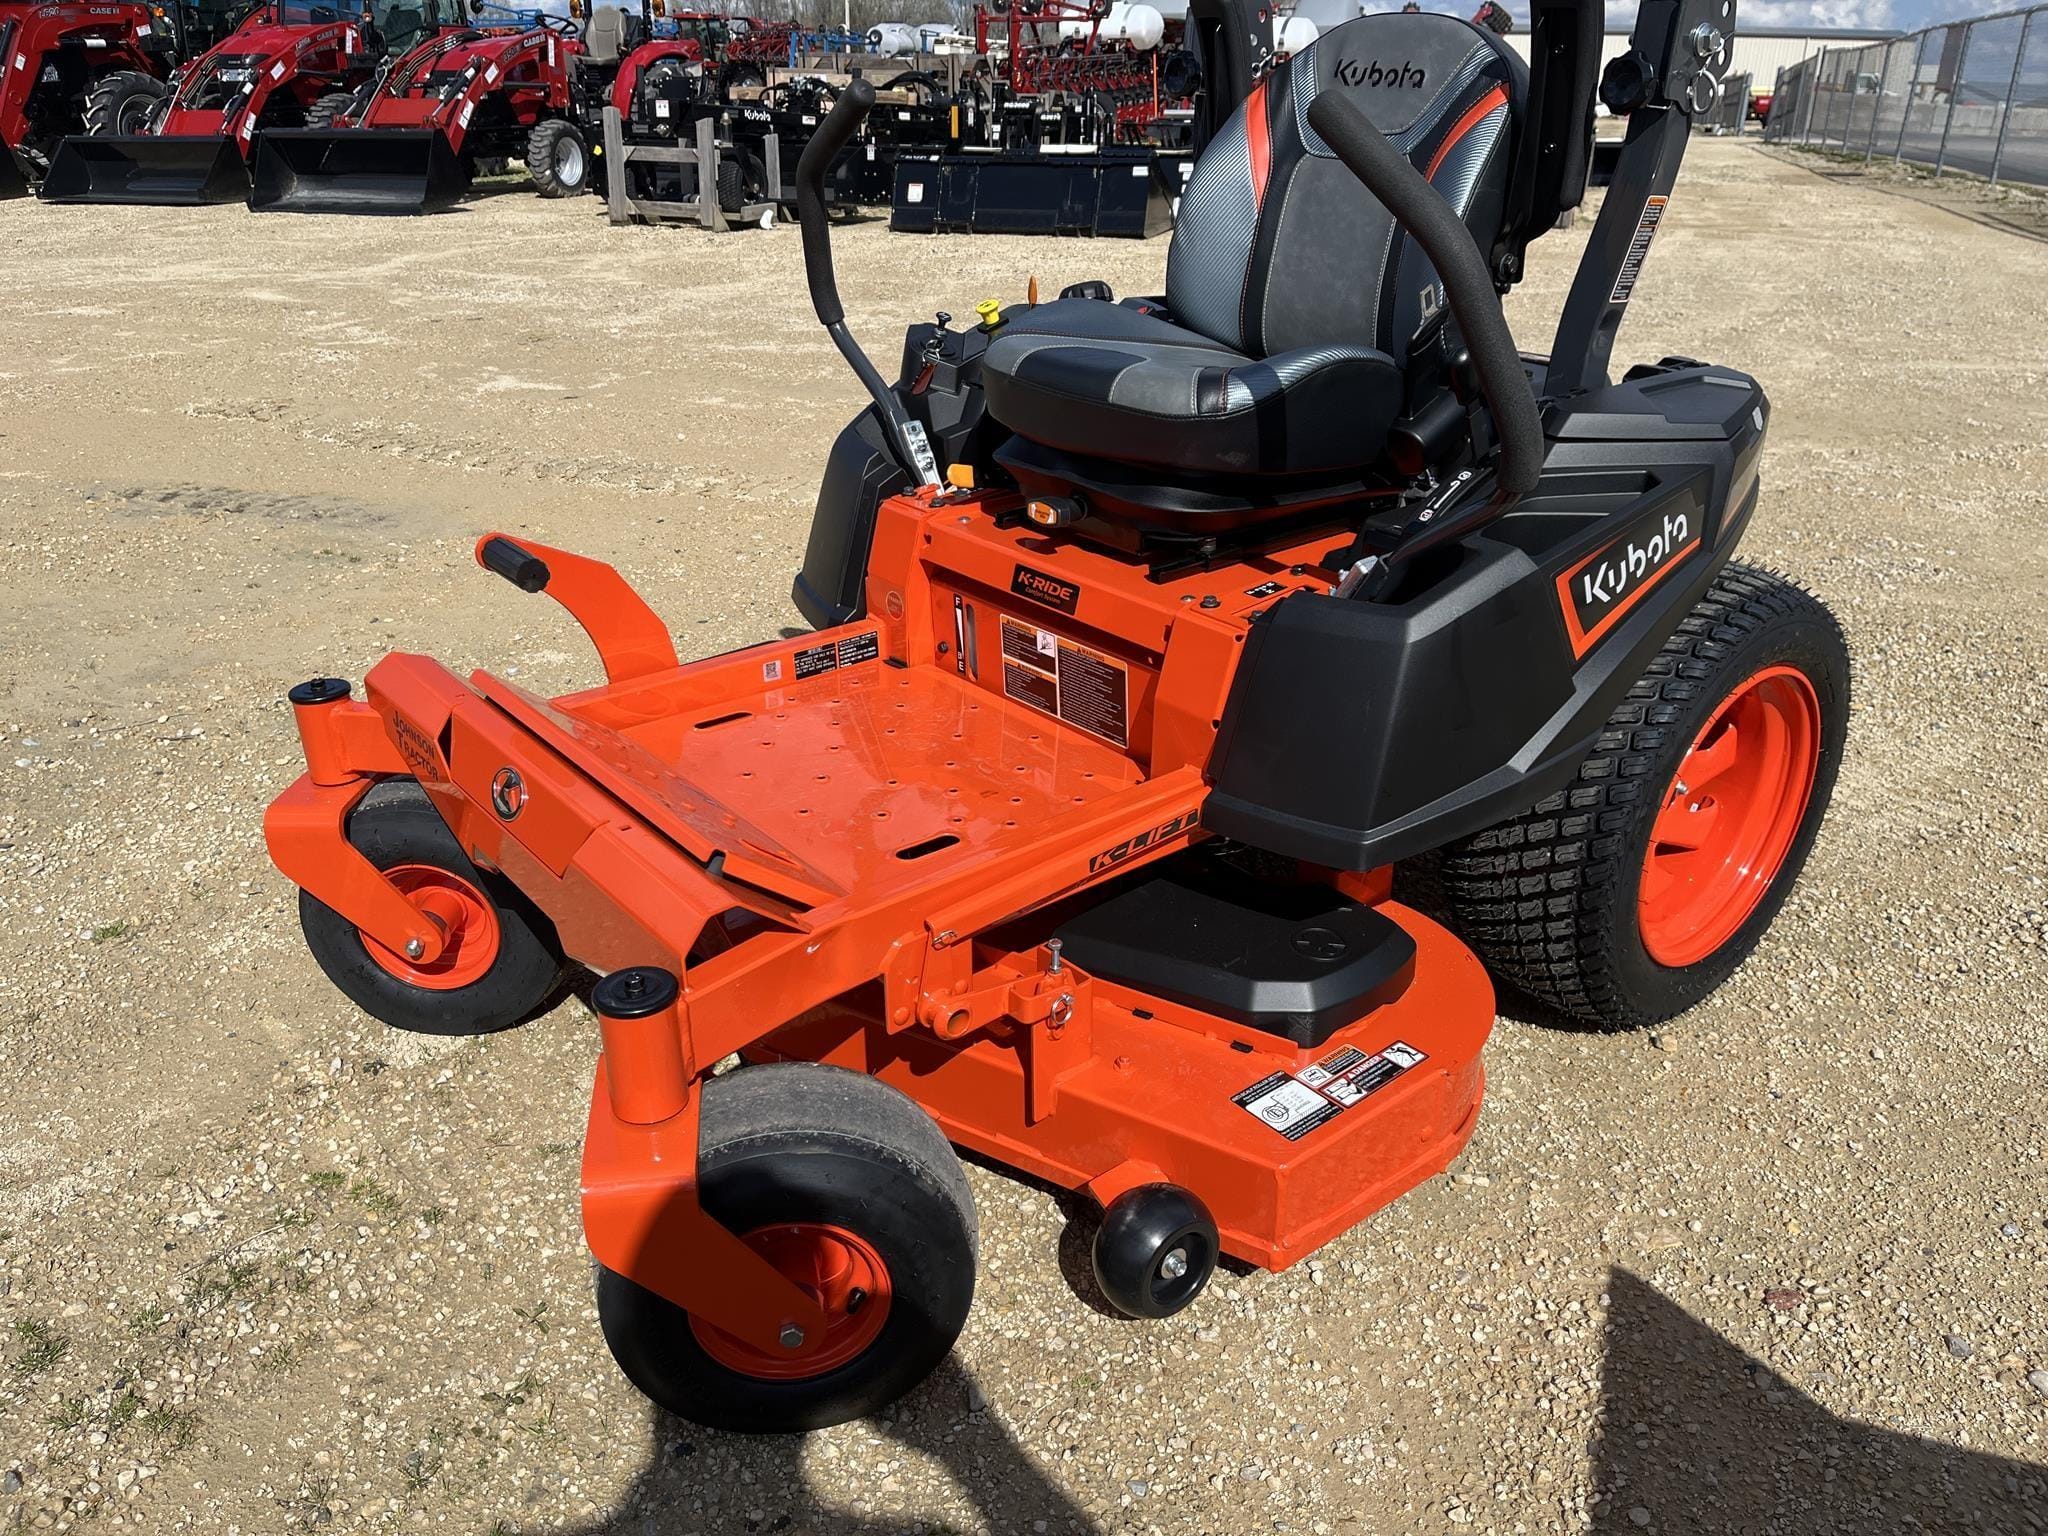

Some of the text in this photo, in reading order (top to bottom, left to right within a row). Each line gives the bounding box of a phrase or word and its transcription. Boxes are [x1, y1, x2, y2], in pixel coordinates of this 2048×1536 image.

[1334, 59, 1426, 88] Kubota
[744, 109, 771, 122] Kubota
[1584, 513, 1687, 604] Kubota
[1018, 571, 1073, 601] K-RIDE
[955, 596, 961, 606] F
[959, 661, 964, 671] E
[393, 710, 435, 760] JOHNSON
[396, 730, 439, 782] TRACTOR
[1093, 809, 1197, 872] K-LIFT
[1322, 1045, 1351, 1065] WARNING
[1352, 1054, 1382, 1075] DANGER
